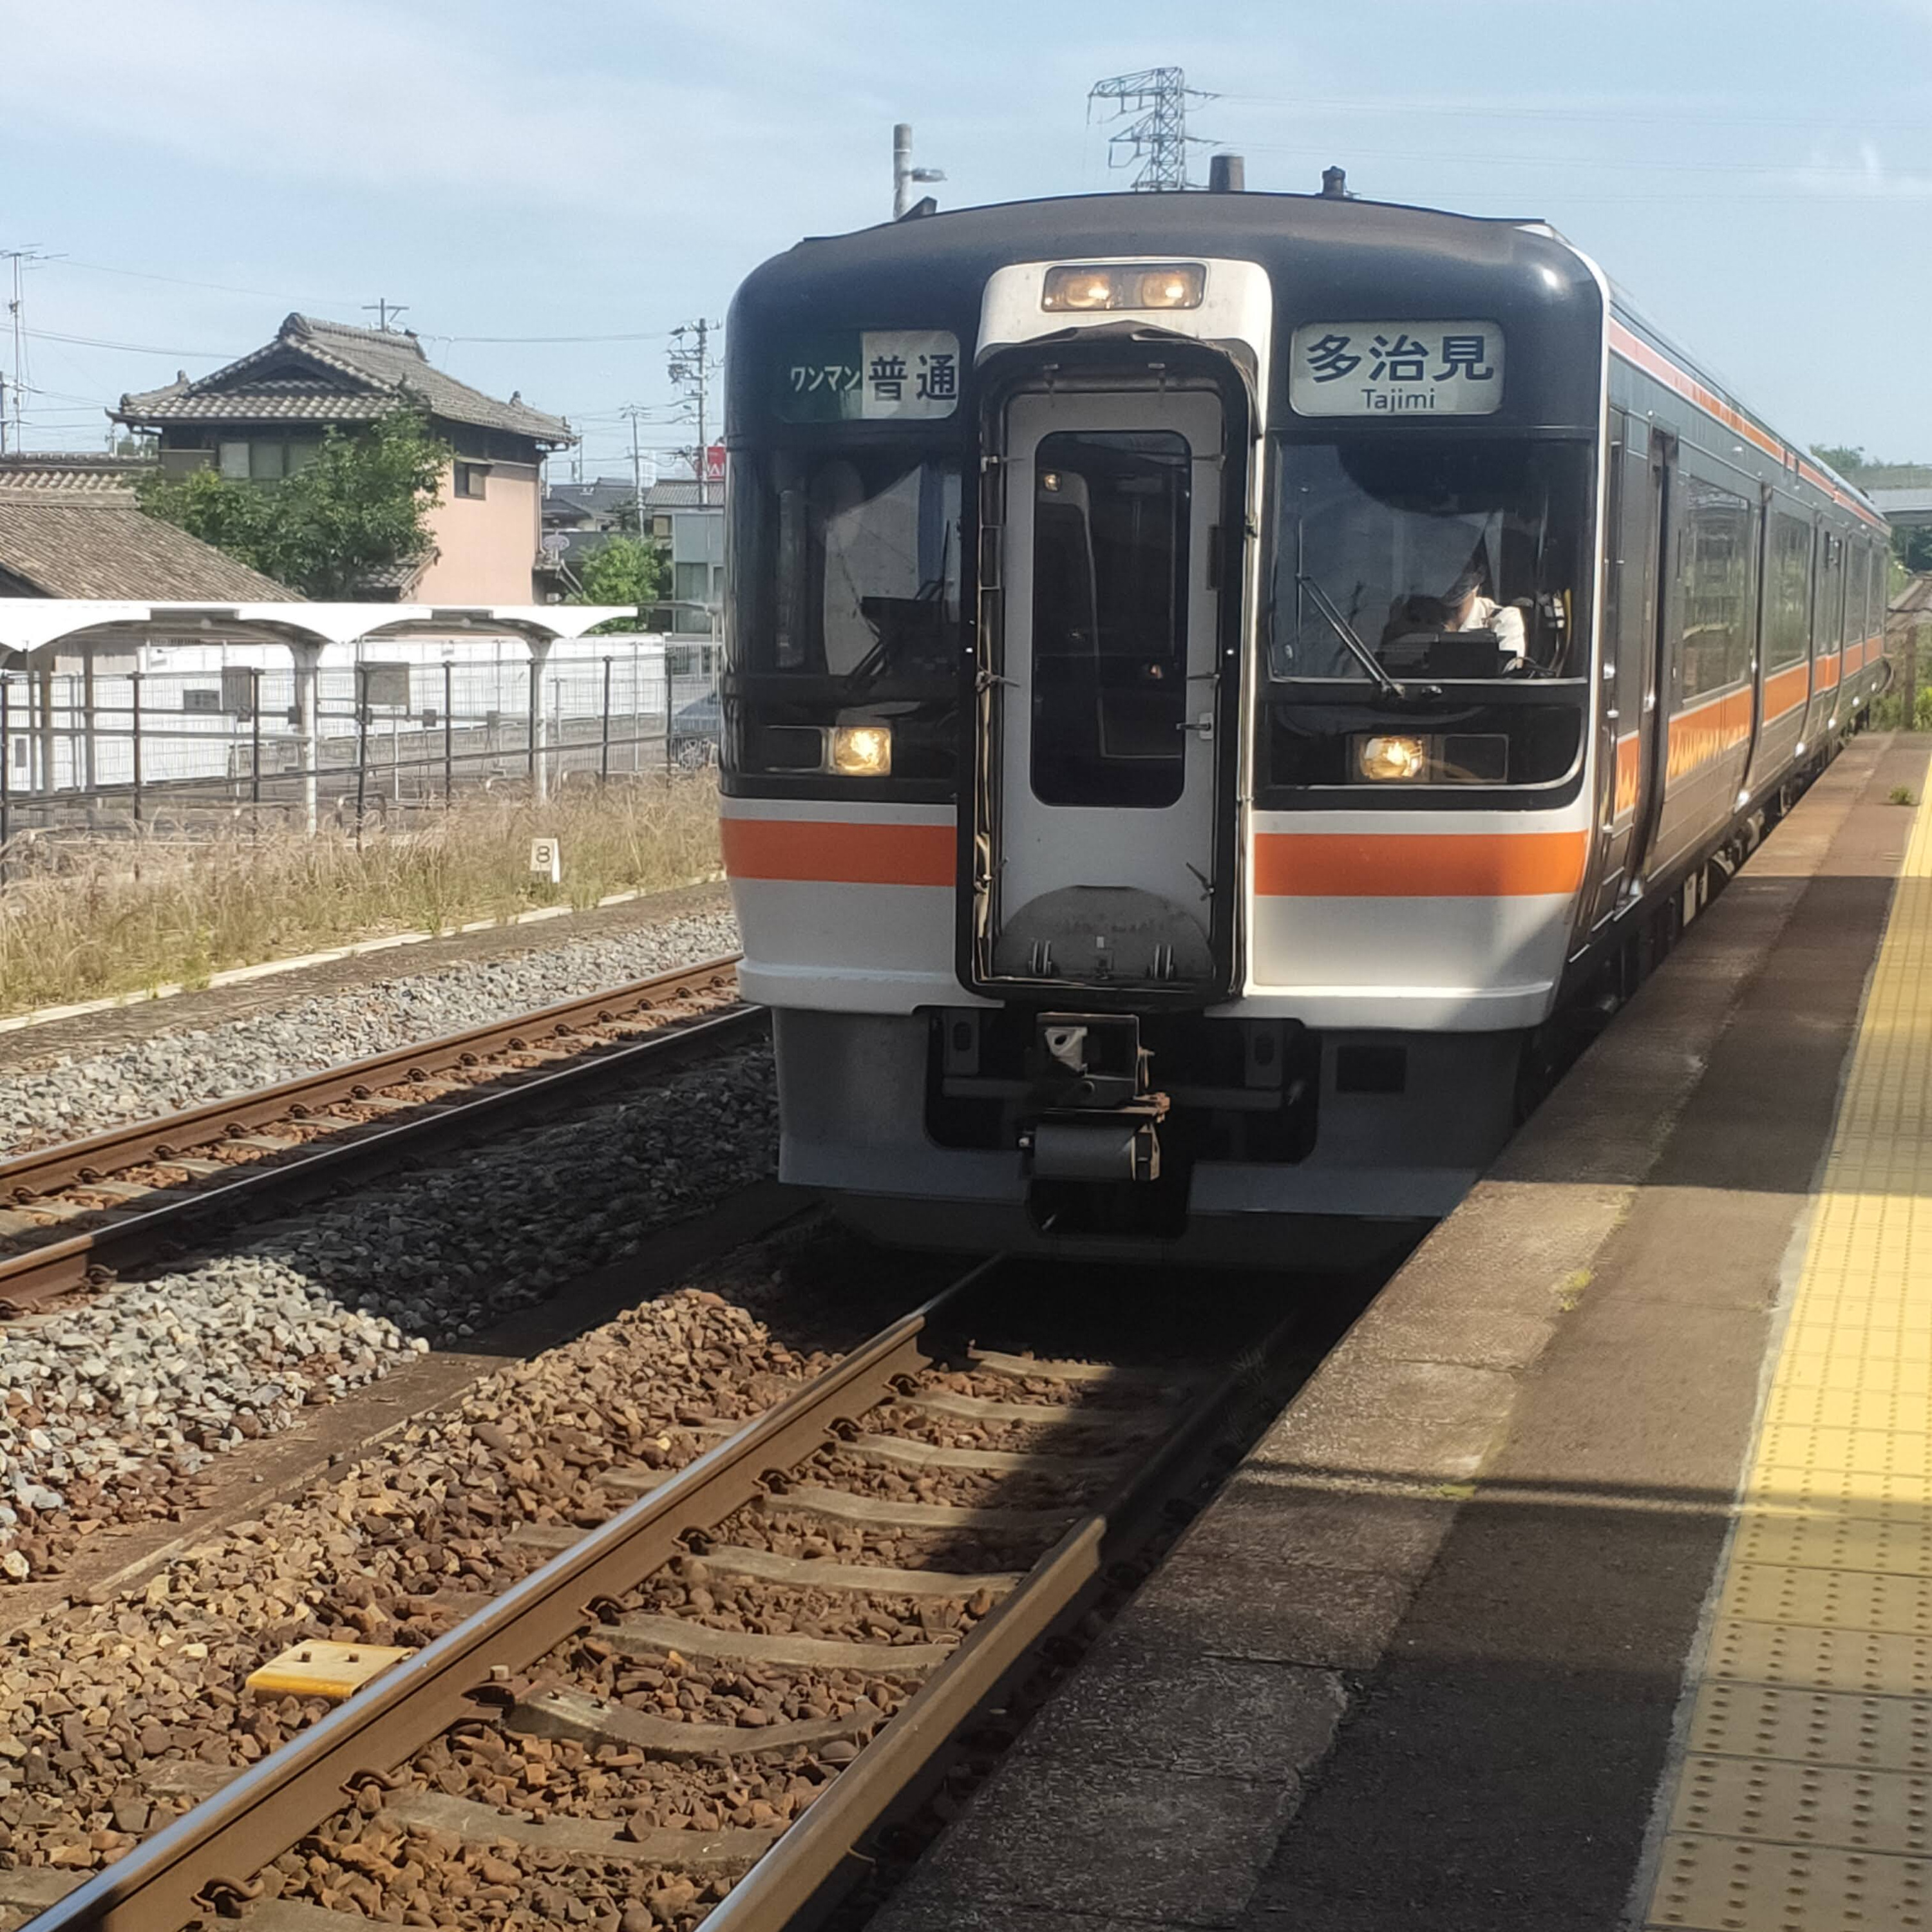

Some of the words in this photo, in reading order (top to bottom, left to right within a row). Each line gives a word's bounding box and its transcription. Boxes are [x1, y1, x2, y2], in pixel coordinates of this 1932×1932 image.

[1306, 334, 1494, 384] 多治見
[790, 365, 860, 392] ワンマン
[868, 354, 958, 401] 普通
[1361, 388, 1436, 413] Tajimi
[536, 845, 551, 864] 8
